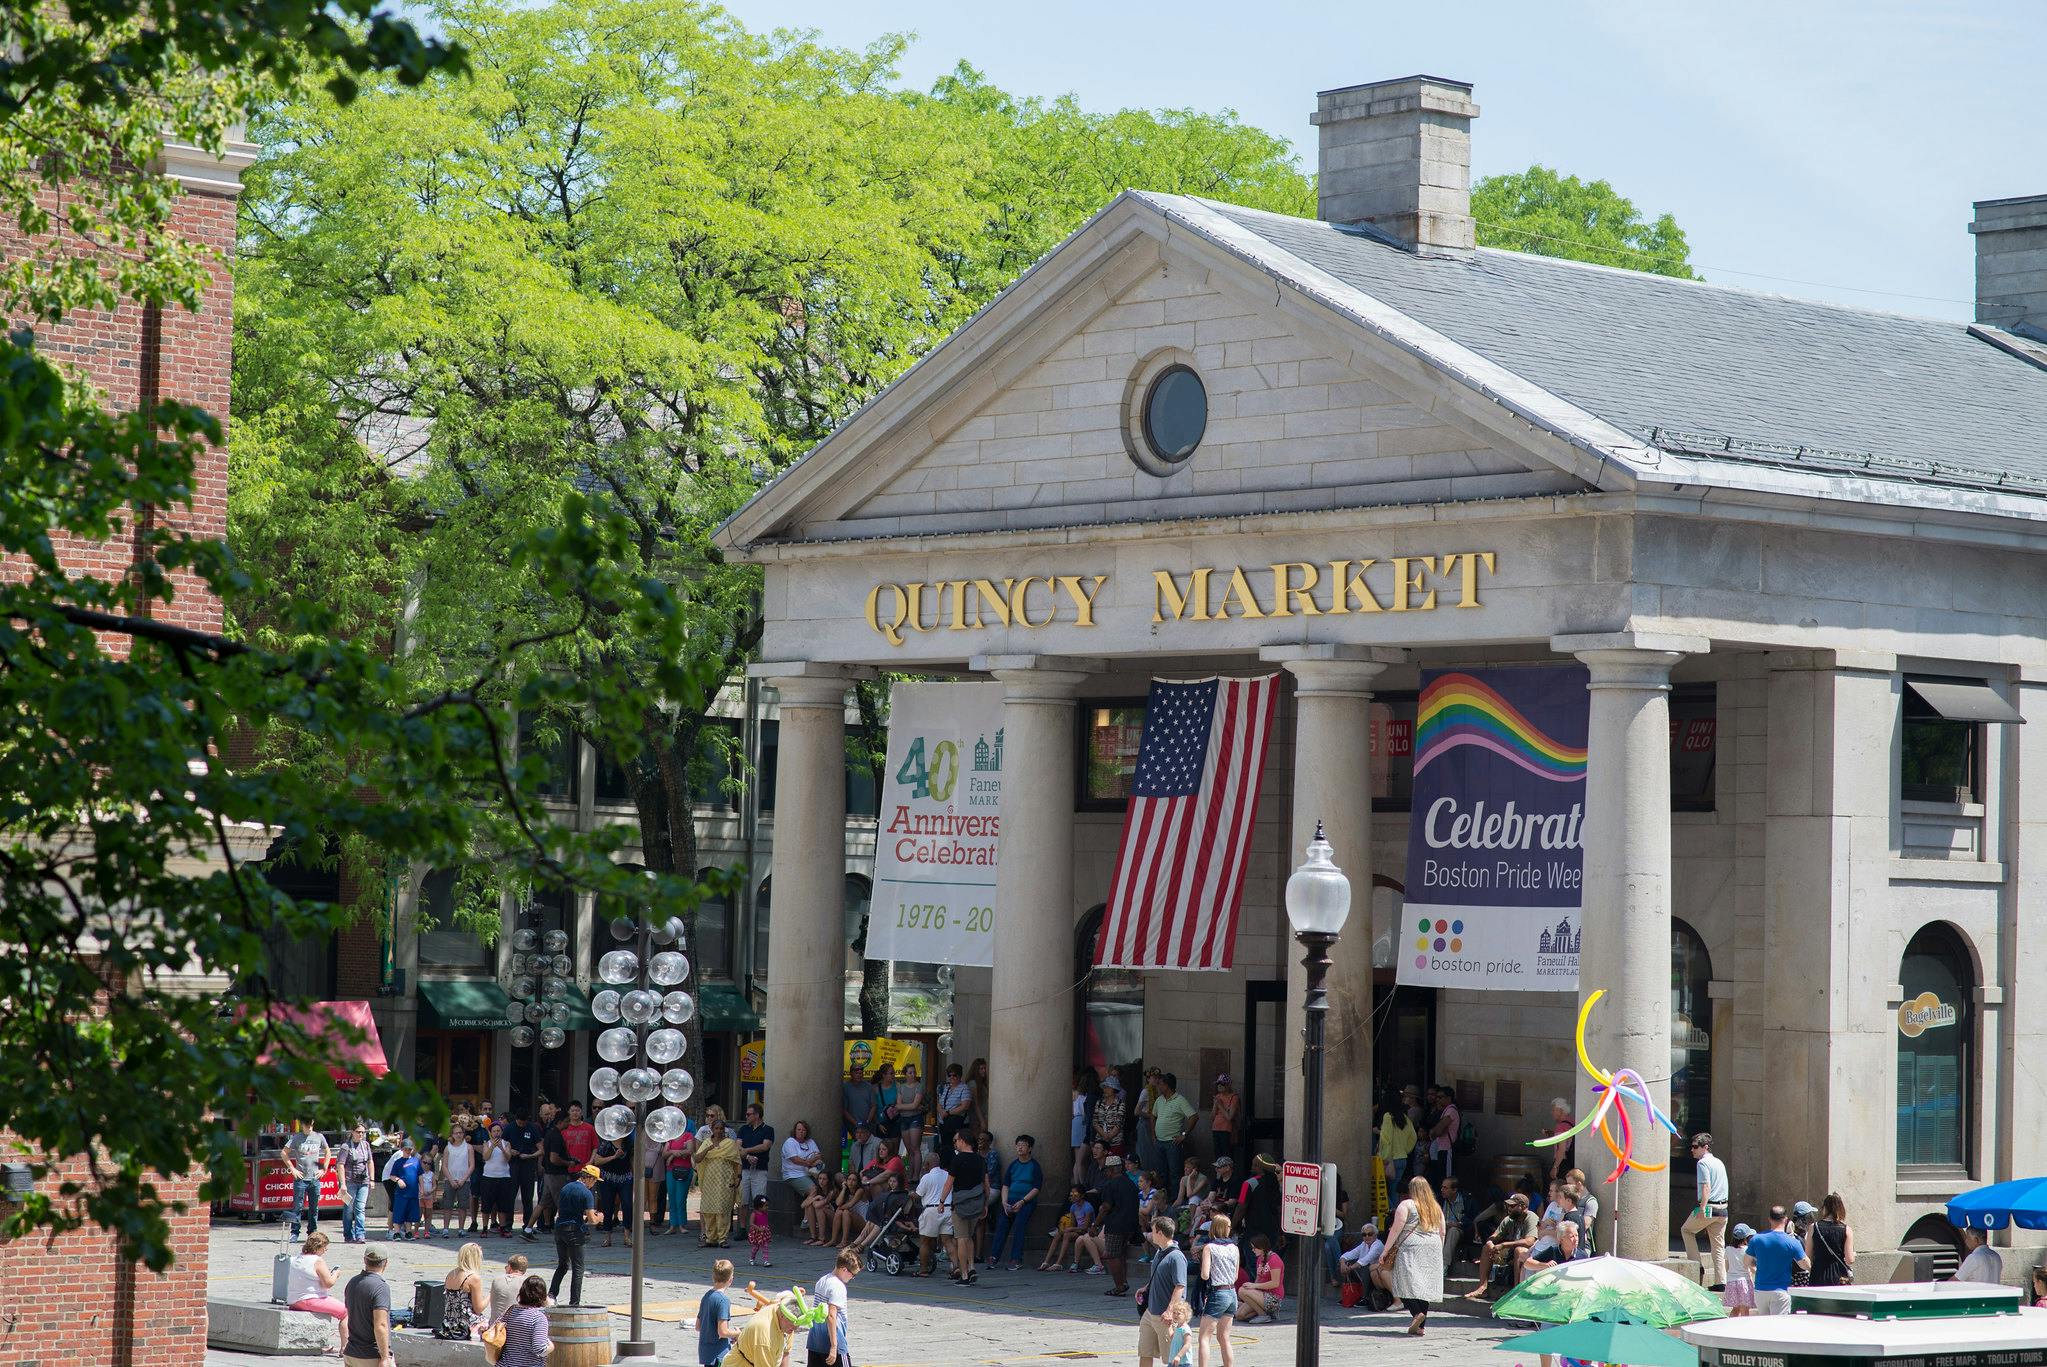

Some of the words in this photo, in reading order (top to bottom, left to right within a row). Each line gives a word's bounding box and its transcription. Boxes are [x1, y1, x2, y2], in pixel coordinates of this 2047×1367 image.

[865, 575, 1108, 646] QUINCY
[1152, 551, 1496, 623] MARKET
[1388, 724, 1408, 736] UNI
[1691, 721, 1713, 733] UNI
[1388, 739, 1409, 755] QLO
[1686, 735, 1711, 750] QLO
[969, 795, 999, 805] MARK
[886, 804, 1000, 837] Annivers
[895, 838, 998, 865] Celebrat
[1423, 859, 1489, 888] Boston
[1495, 860, 1541, 889] Pride
[1547, 861, 1581, 889] Wee
[896, 903, 947, 930] 1976
[965, 906, 993, 932] 20
[1430, 955, 1480, 973] boston
[1537, 956, 1566, 966] Faneuil
[1536, 968, 1580, 976] MARKETPLAC
[1906, 1005, 1953, 1025] Bagelville
[1286, 1165, 1302, 1175] TOW
[1302, 1167, 1319, 1177] ZONE
[265, 1182, 294, 1191] CHICKE
[1295, 1184, 1309, 1194] NO
[1285, 1195, 1317, 1206] STOPPING
[1294, 1207, 1308, 1216] Fire
[1292, 1216, 1308, 1226] Lane
[1721, 1353, 1757, 1366] TROLLEY
[1757, 1356, 1784, 1367] TOURS
[1935, 1357, 1954, 1367] FREE
[1955, 1355, 1977, 1366] MAPS
[1987, 1353, 2018, 1365] TROLLEY
[2019, 1352, 2043, 1362] TOURS
